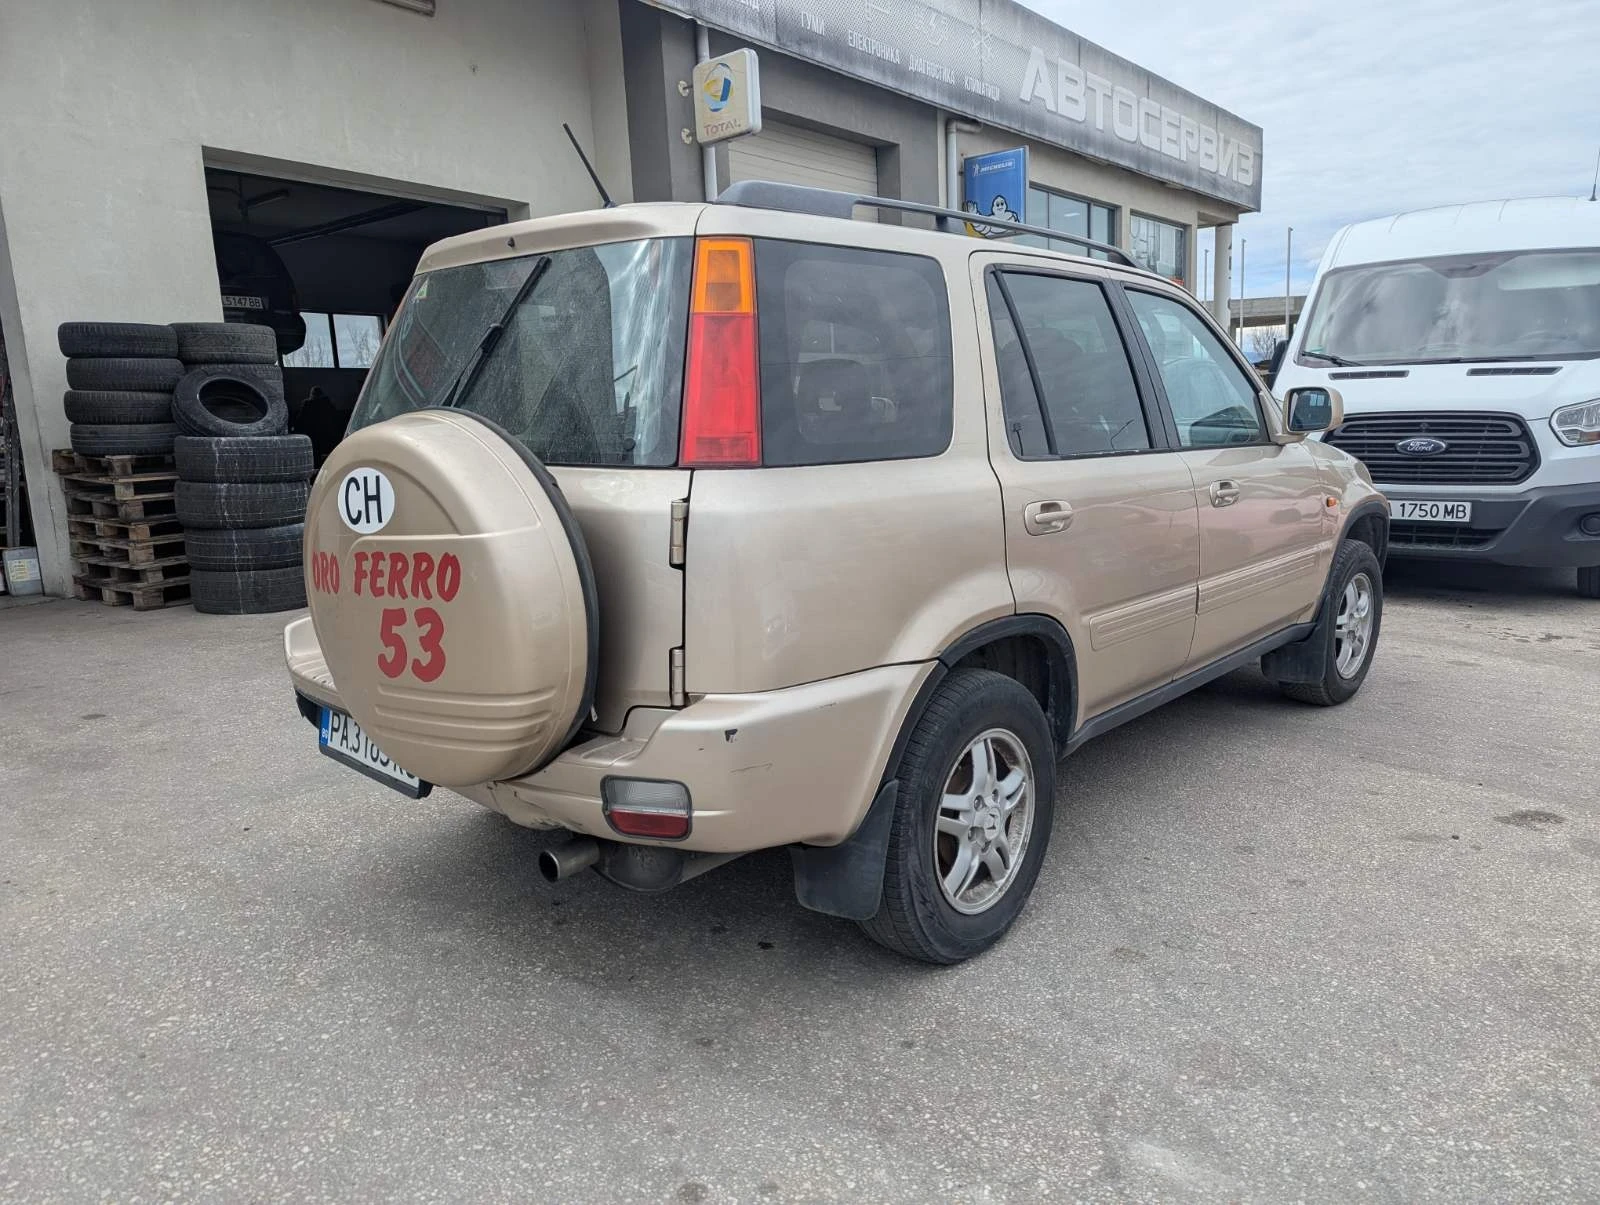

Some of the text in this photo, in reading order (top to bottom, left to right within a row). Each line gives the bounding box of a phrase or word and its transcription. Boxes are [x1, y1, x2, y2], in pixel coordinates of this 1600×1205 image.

[848, 29, 901, 65] ЕЛЕКТРОНИКА
[703, 118, 742, 137] TOTAL
[1019, 46, 1255, 187] АВТОСЕРВИЗ
[1407, 441, 1435, 452] Ford
[344, 475, 383, 526] CH
[1399, 502, 1467, 520] 1750 MB
[353, 551, 462, 603] FERRO
[377, 606, 447, 684] 53
